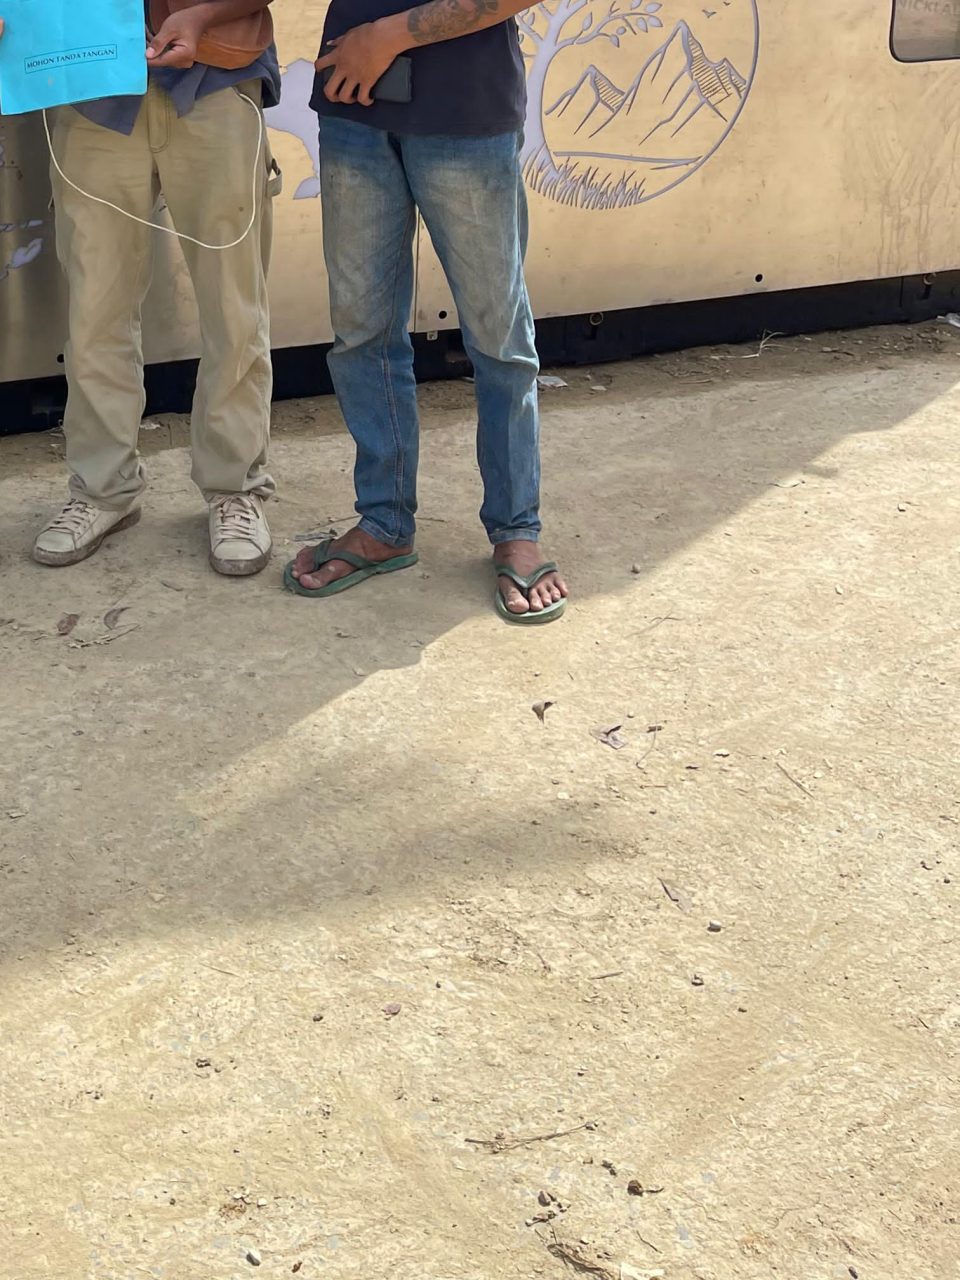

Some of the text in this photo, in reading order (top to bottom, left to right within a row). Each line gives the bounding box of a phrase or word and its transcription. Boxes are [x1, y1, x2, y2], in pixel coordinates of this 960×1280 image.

[27, 49, 114, 68] MOHON TANDA TANGAN
